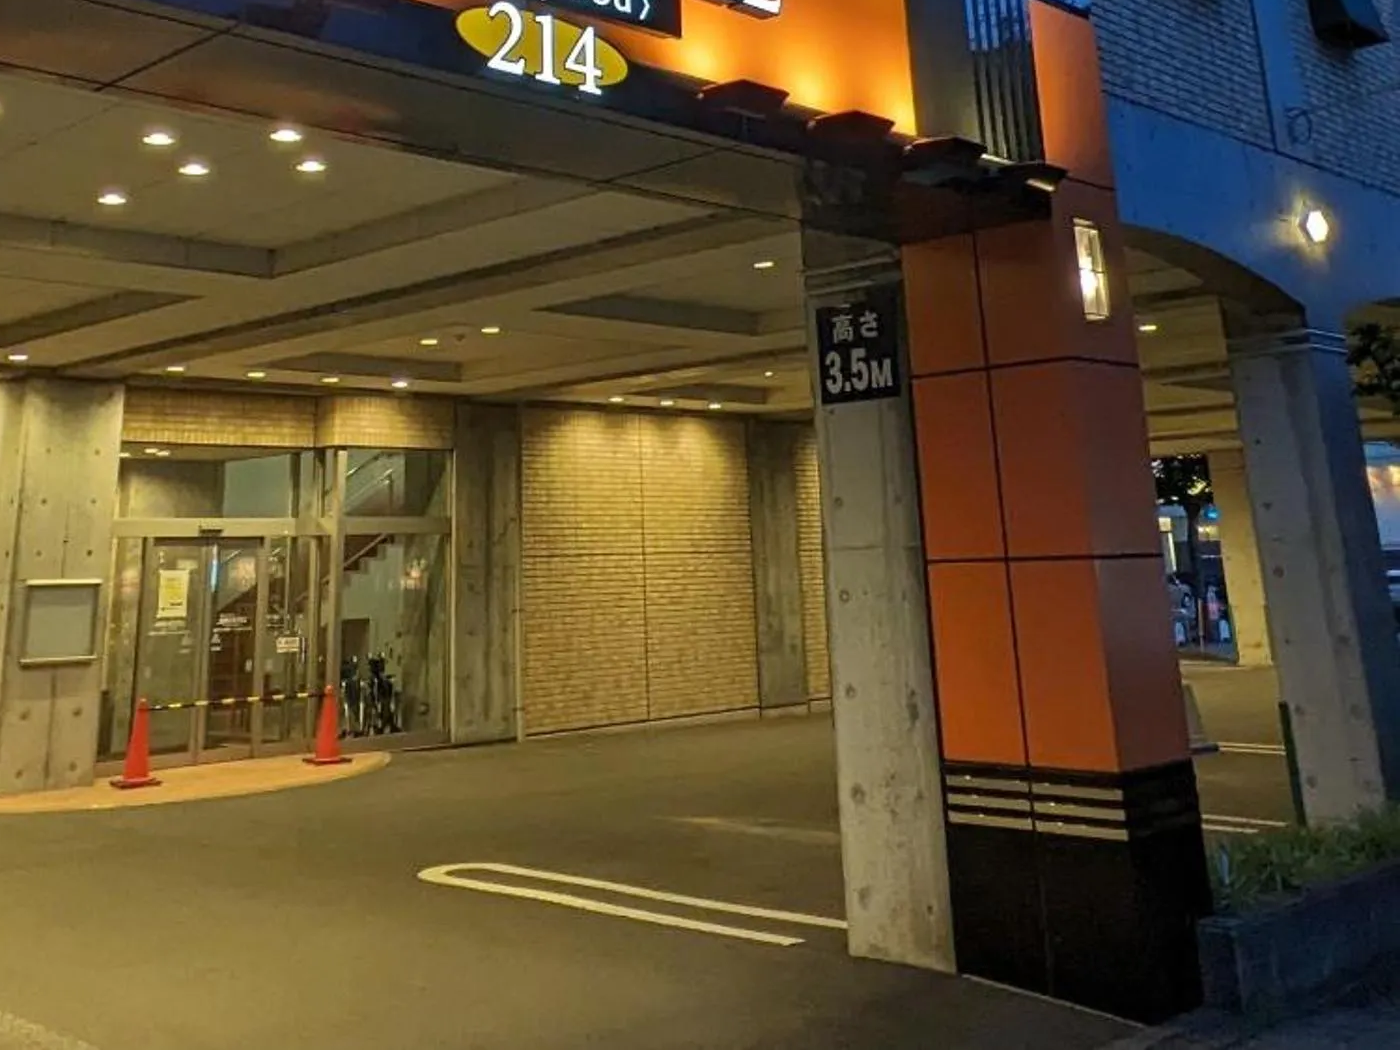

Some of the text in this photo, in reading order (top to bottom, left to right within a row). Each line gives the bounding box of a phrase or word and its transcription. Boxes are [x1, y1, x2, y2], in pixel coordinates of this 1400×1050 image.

[486, 0, 603, 96] 214
[831, 310, 879, 344] 高さ
[825, 348, 893, 394] 3.5M
